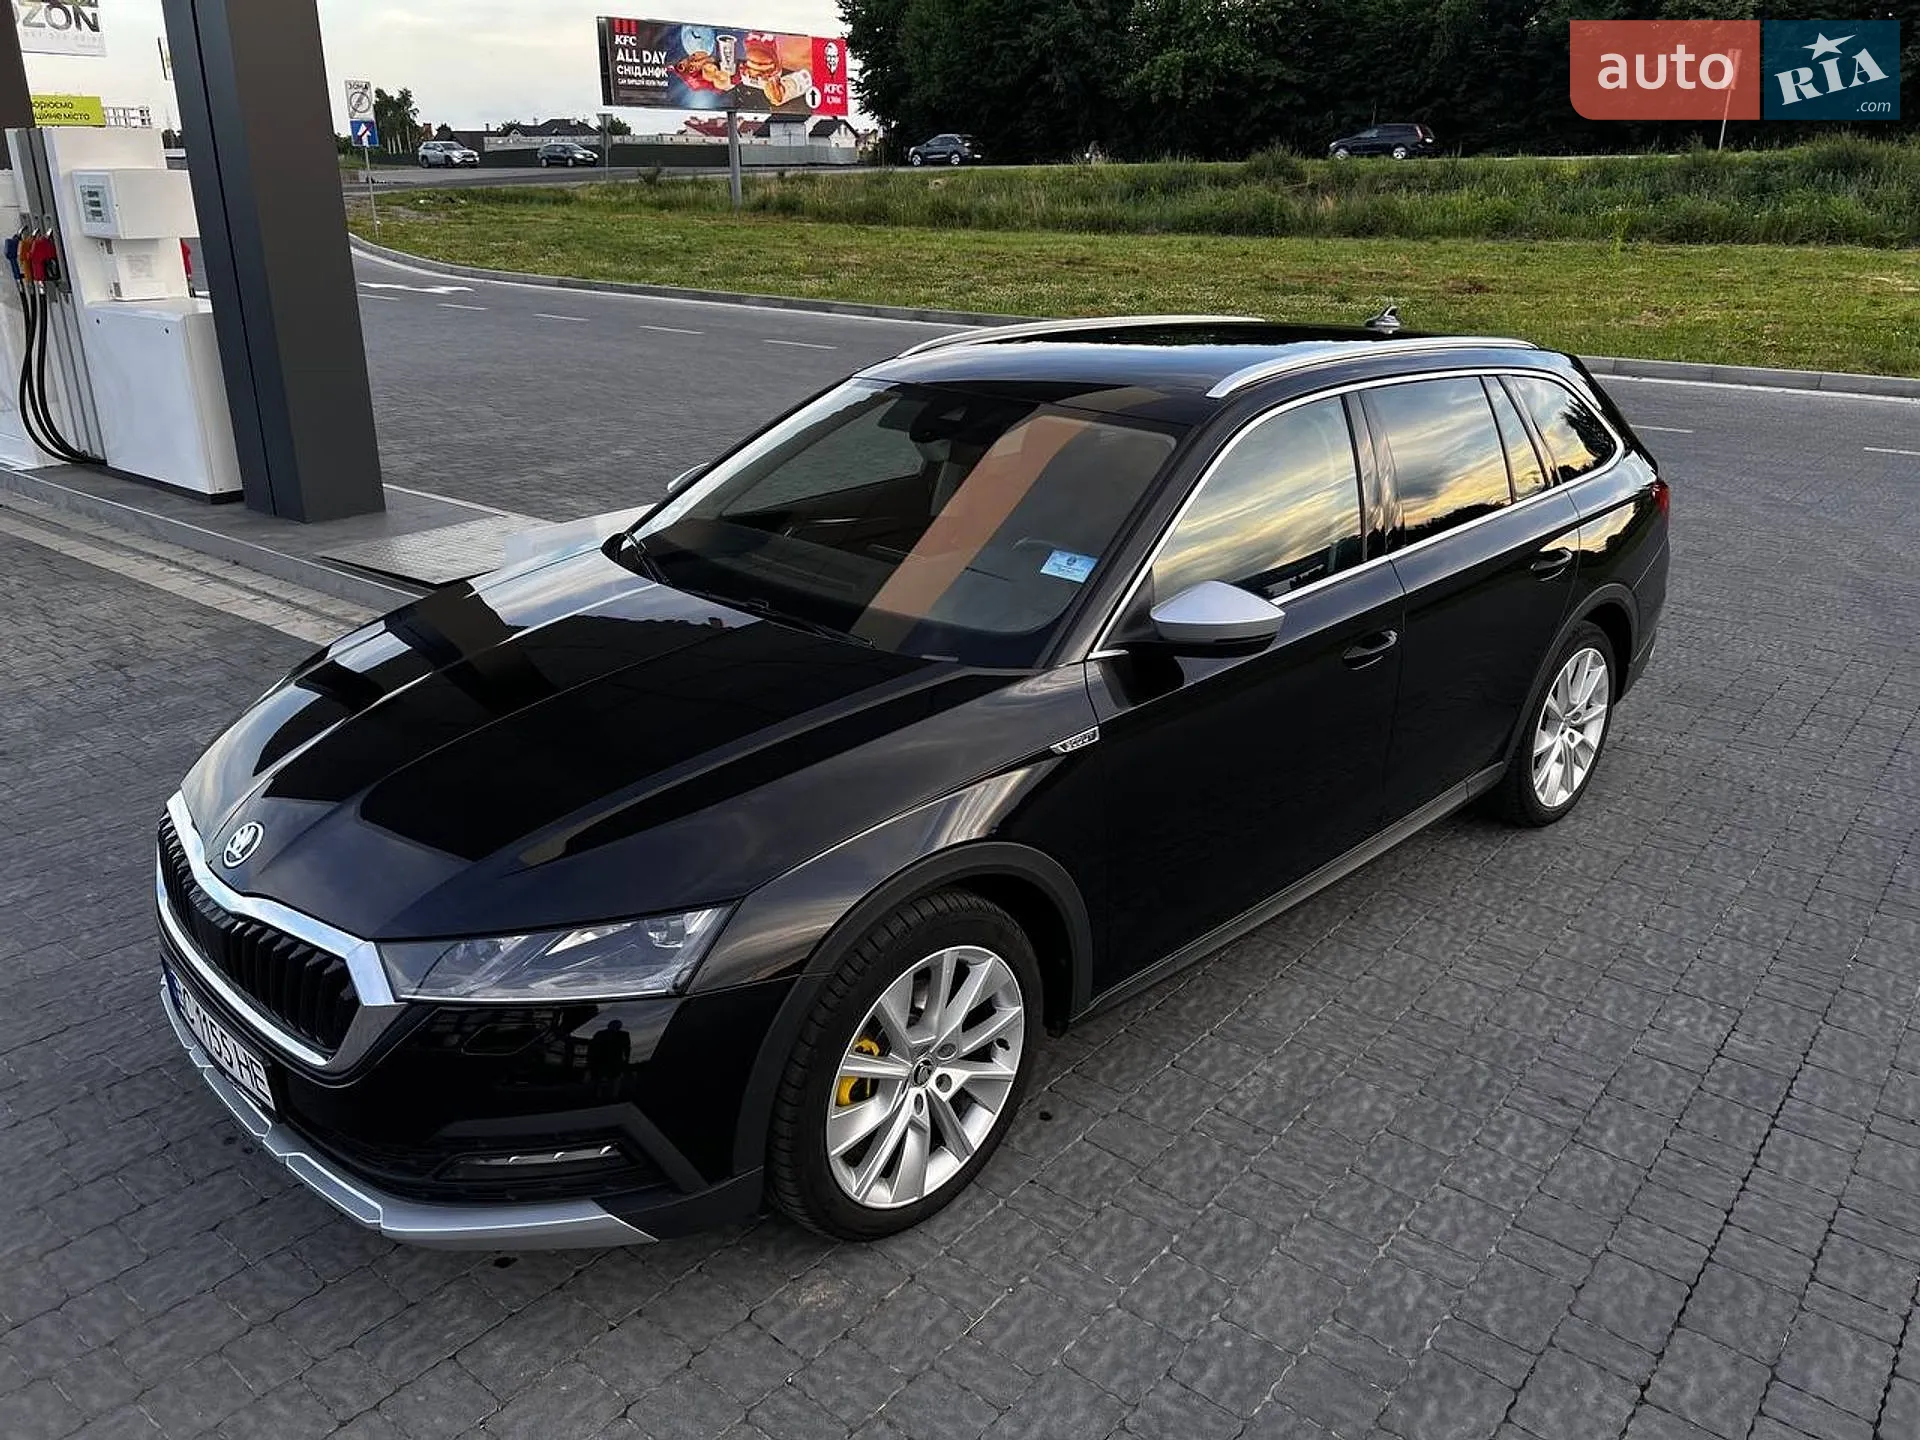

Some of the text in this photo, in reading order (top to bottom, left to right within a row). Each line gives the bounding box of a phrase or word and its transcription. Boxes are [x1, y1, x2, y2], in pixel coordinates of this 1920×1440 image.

[615, 34, 638, 46] KFC
[616, 47, 667, 65] ALL DAY
[616, 64, 669, 78] СНІДАНОК
[824, 83, 844, 95] KFC
